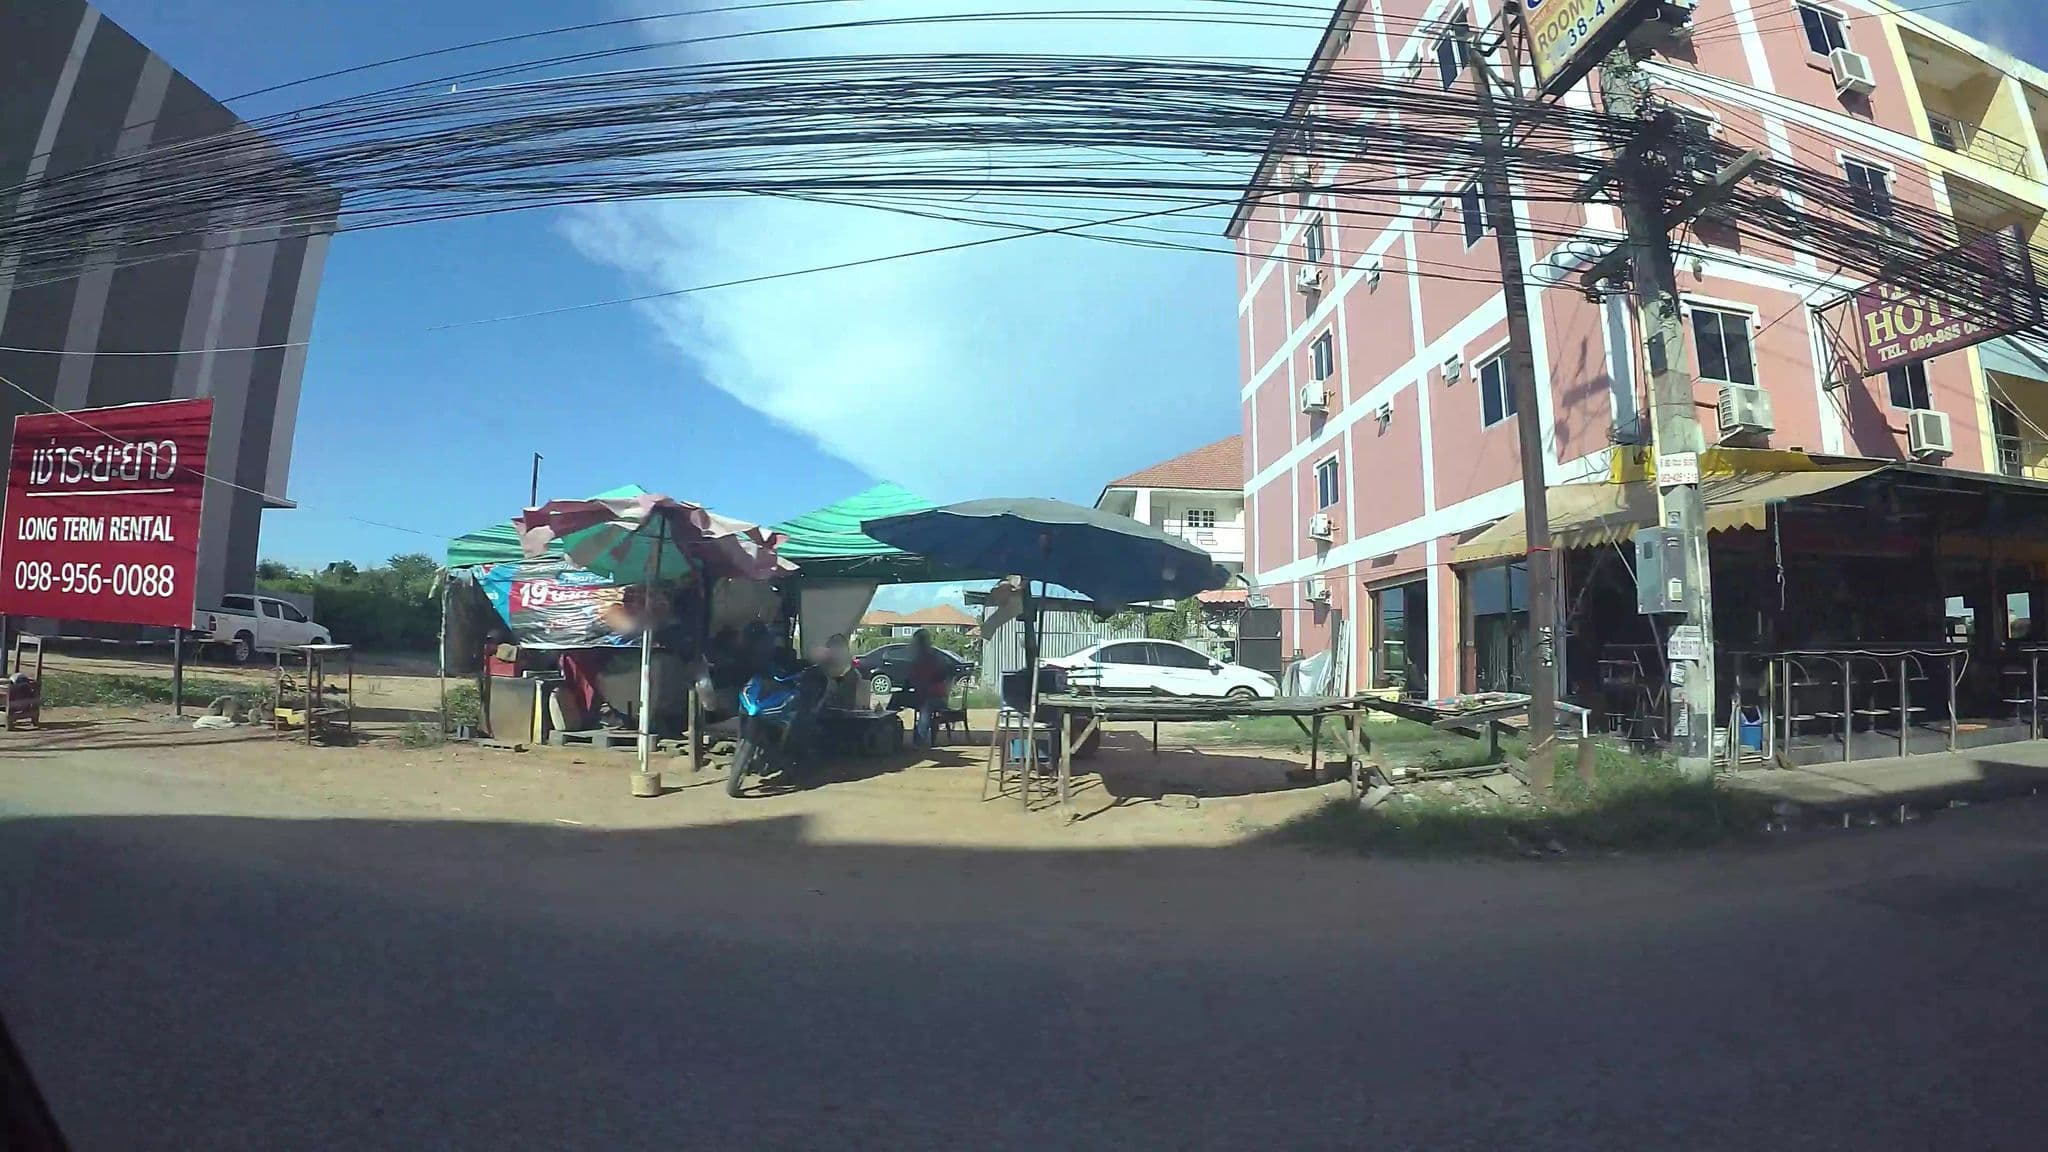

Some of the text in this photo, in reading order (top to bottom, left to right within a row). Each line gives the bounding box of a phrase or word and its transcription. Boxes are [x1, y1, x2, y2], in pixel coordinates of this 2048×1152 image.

[1537, 0, 1585, 51] ROOM
[29, 437, 177, 484] เช่าระยะยาว
[18, 516, 174, 542] LONG TERM RENTAL
[15, 560, 175, 598] 098-956-0088
